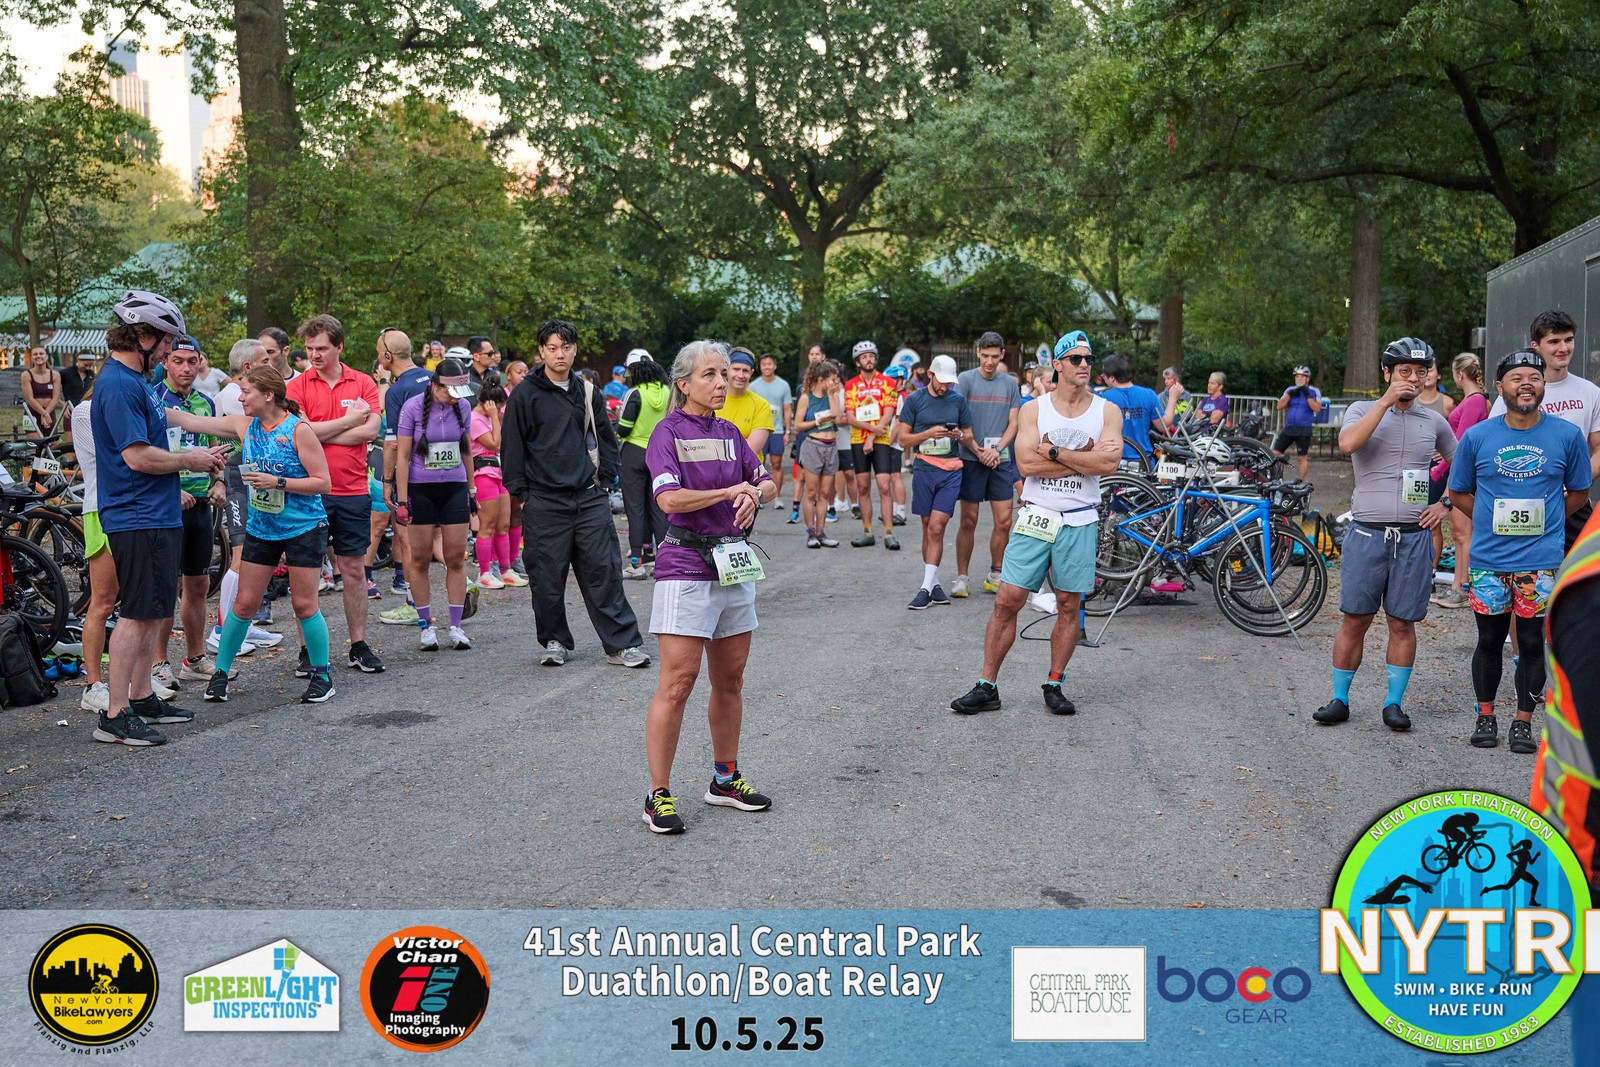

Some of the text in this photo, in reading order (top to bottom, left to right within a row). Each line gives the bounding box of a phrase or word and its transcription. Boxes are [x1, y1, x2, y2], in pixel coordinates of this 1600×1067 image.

[1538, 399, 1584, 413] ARVARD
[434, 450, 453, 461] 128
[1498, 444, 1544, 455] CARL SCHURZ
[43, 461, 58, 472] 125
[1497, 467, 1543, 478] PICKLEBALL
[1038, 478, 1082, 490] LATIRON
[1027, 514, 1050, 530] 138
[1510, 509, 1530, 524] 35
[728, 551, 752, 569] 554
